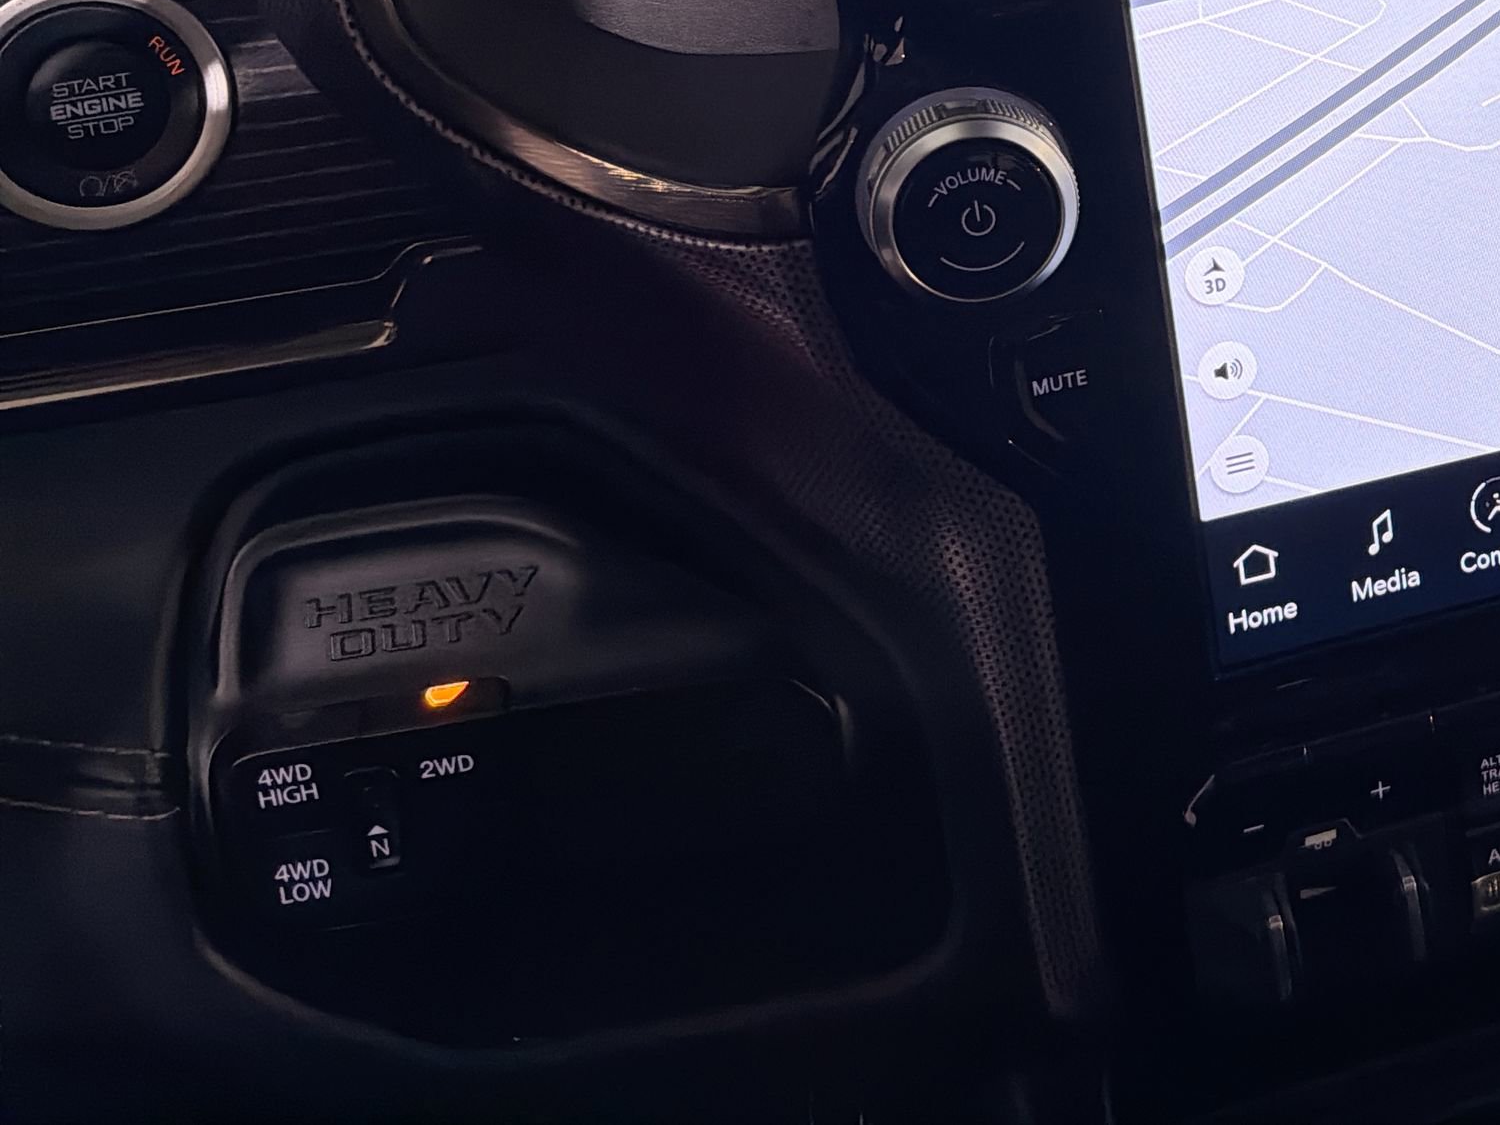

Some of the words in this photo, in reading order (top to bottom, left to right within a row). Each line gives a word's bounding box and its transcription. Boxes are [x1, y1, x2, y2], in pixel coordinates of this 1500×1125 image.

[149, 35, 186, 77] RUN
[51, 72, 132, 99] START
[50, 92, 145, 121] ENGINE
[67, 116, 135, 140] STOP
[933, 167, 1008, 198] VOLUME
[1204, 277, 1227, 295] 3D
[1031, 369, 1089, 397] MUTE
[304, 565, 540, 629] HEAVY
[1351, 567, 1421, 603] Media
[1228, 601, 1298, 635] Home
[328, 606, 524, 662] DUTY
[257, 764, 313, 787] 4WD
[418, 754, 475, 779] 2WD
[257, 782, 320, 810] HIGH
[370, 838, 391, 858] N
[274, 858, 330, 884] 4WD
[279, 878, 333, 906] LOW
